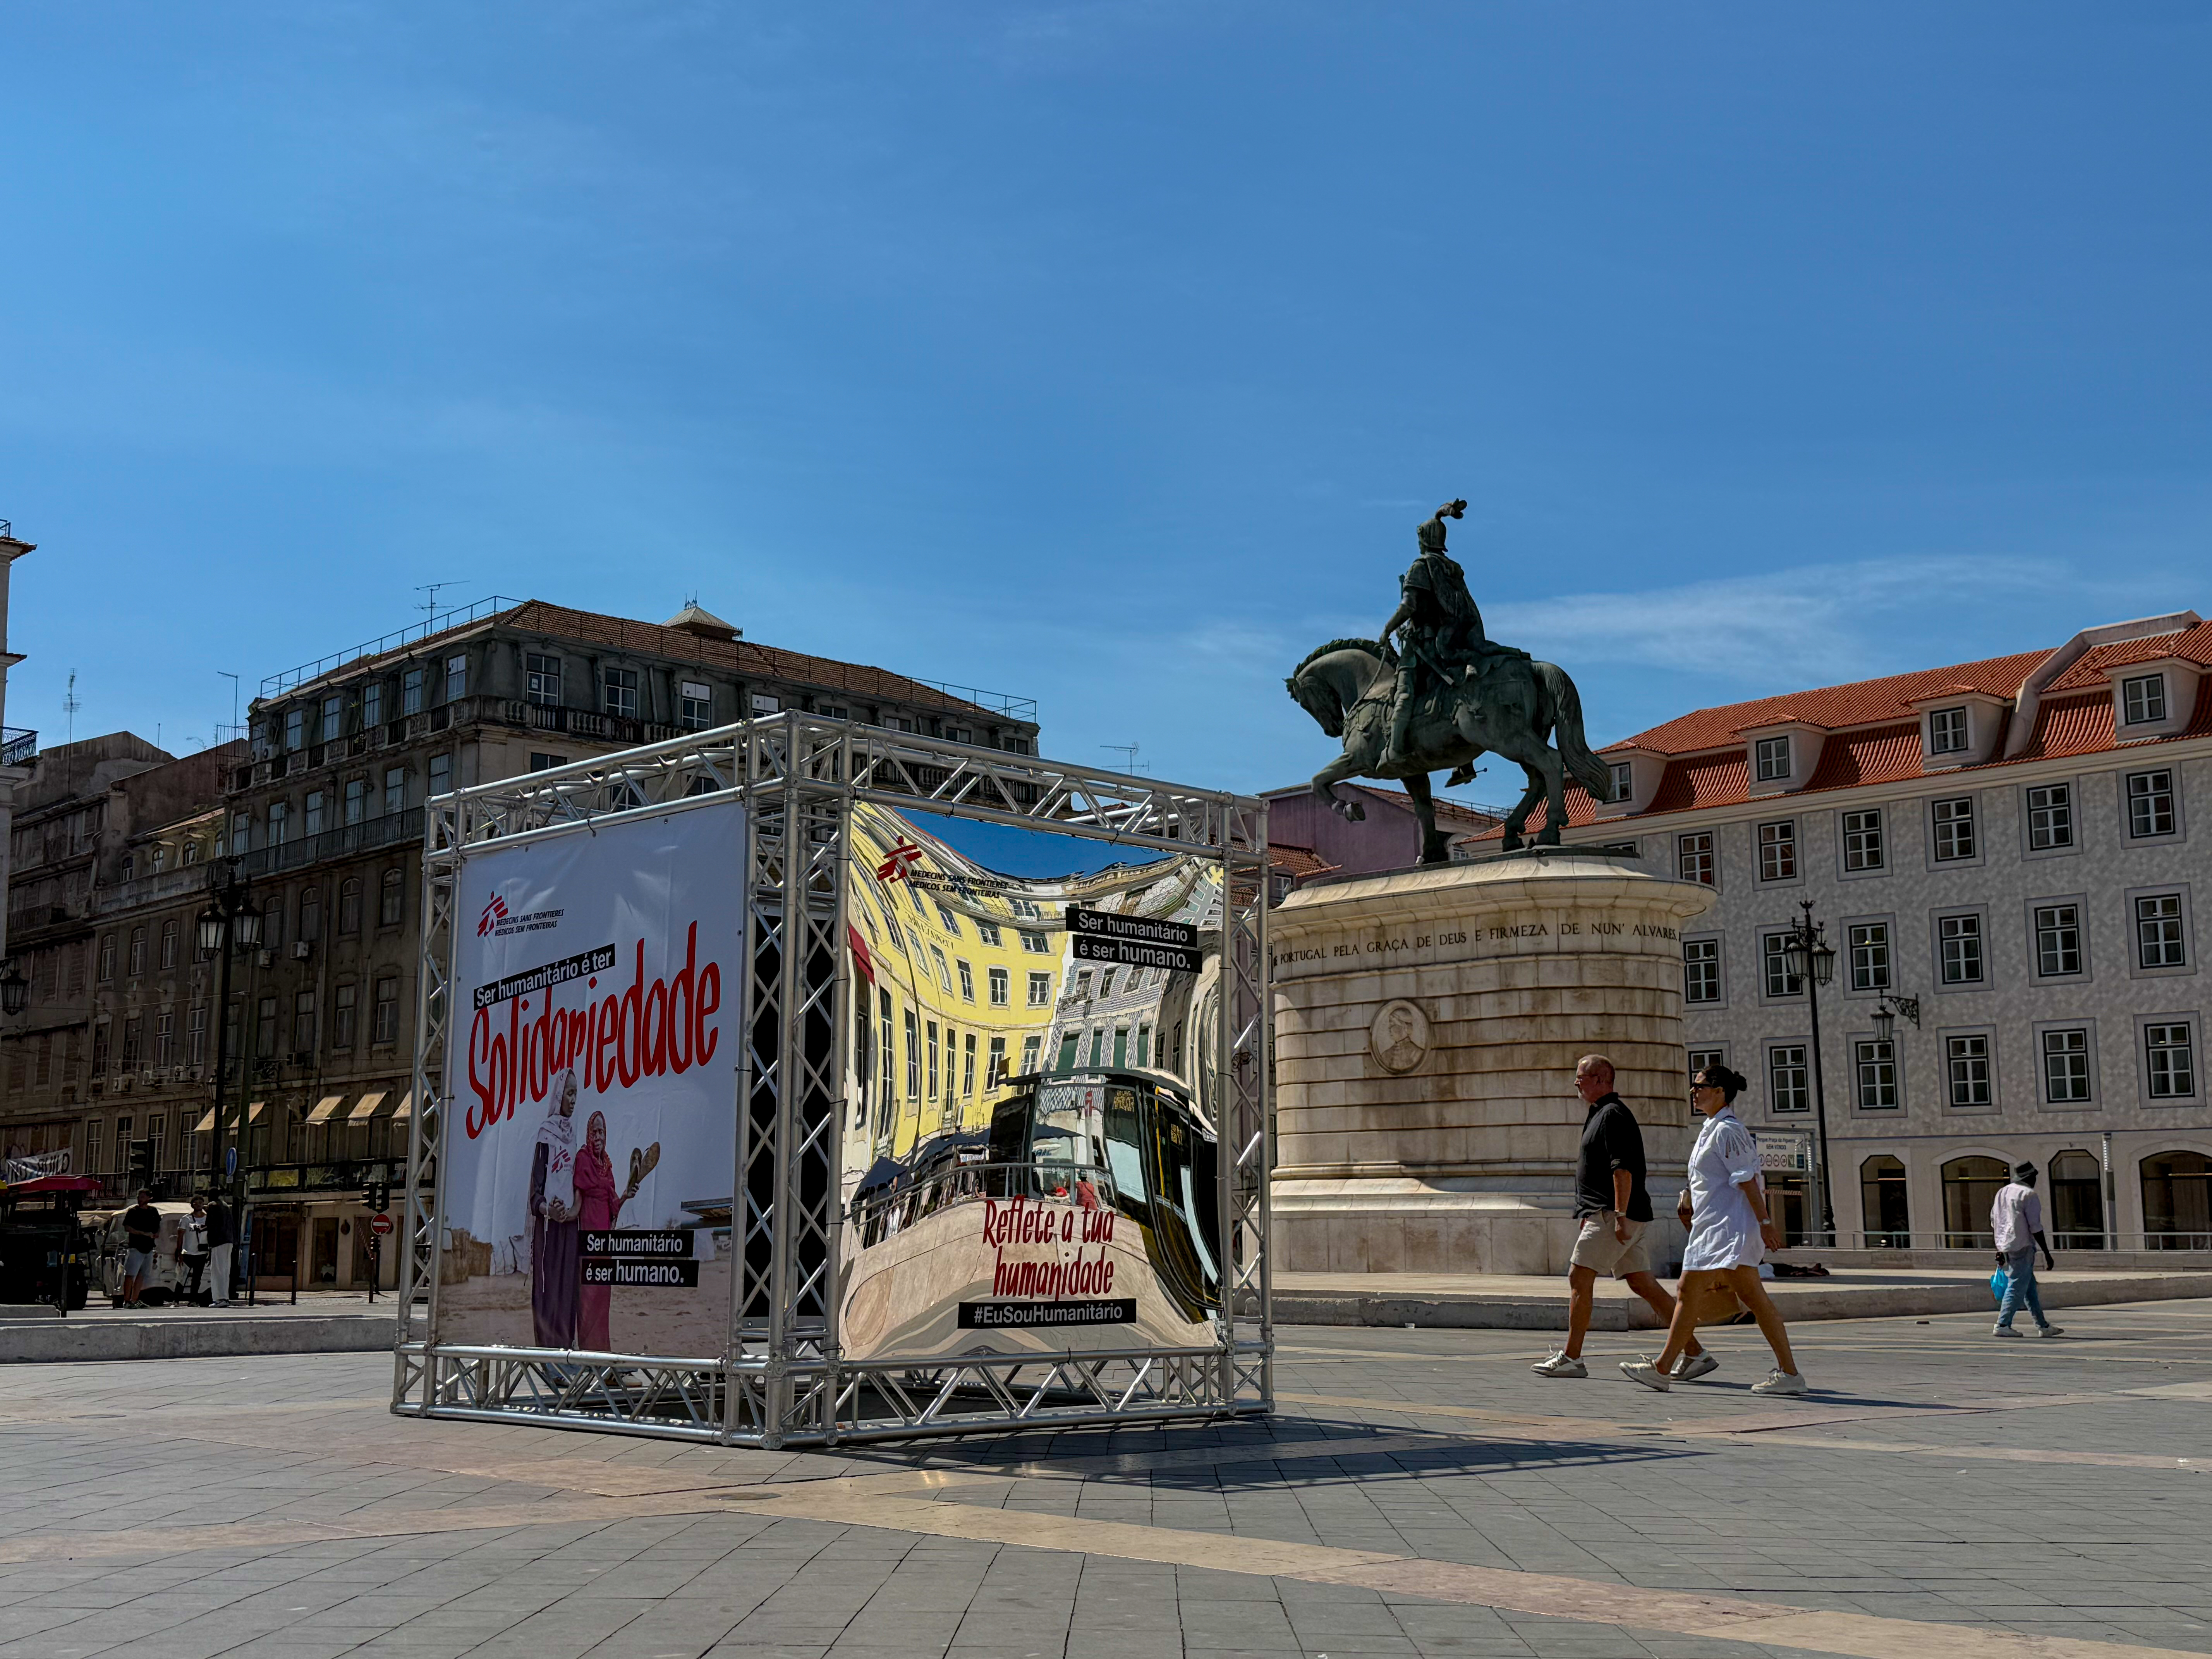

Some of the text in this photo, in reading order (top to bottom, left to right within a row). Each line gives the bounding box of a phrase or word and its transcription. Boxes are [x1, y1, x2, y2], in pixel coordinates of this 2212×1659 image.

[910, 870, 1008, 889] MEDECINS SANS FRONTIERES
[910, 881, 1000, 898] MEDICOS SEM FRONTEIRAS
[495, 927, 514, 936] MEDICOS
[526, 921, 558, 932] FRONTEIRAS
[496, 909, 564, 926] MEDECINS SANS FRONTIERES
[1079, 912, 1188, 942] Ser humanitário
[1080, 939, 1190, 969] é ser humano.
[1280, 948, 1327, 964] PORTUGAL
[1334, 944, 1359, 957] PELA
[1367, 938, 1409, 953] GRAÇA
[1417, 936, 1432, 948] DE
[1439, 932, 1467, 945] DEUS
[1475, 930, 1481, 941] E
[1490, 924, 1548, 939] FIRMEZA
[1561, 923, 1580, 935] DE
[1592, 923, 1624, 935] NUN'
[1633, 924, 1677, 941] ALVARES,
[477, 951, 612, 1007] Ser humanitário é ter
[466, 920, 721, 1140] Solidariedade
[983, 1194, 1115, 1249] Reflete a tua
[587, 1233, 683, 1252] Ser humanitário
[586, 1259, 684, 1283] é ser humano.
[993, 1246, 1114, 1301] humanidade
[974, 1302, 1123, 1323] #EuSouHumanitário
